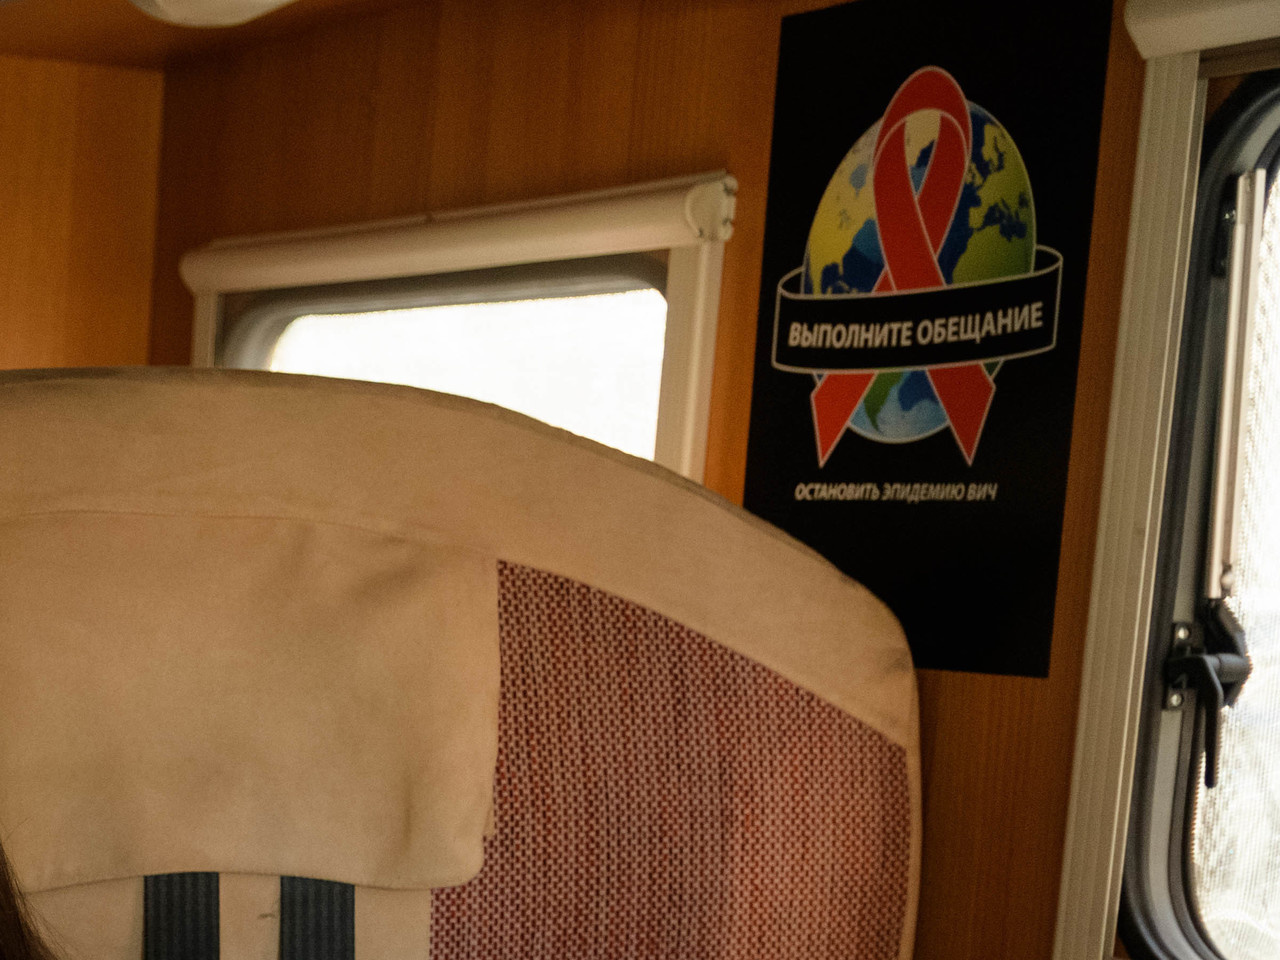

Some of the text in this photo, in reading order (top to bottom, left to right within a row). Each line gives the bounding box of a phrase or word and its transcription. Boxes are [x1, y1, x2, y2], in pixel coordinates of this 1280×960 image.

[788, 301, 1044, 349] ВЫПОЛНИТЕ ОБЕЩАНИЕ
[794, 482, 998, 504] ОСТАНОВИТЬ ЭПИДЕМИЮ ВИЧ
